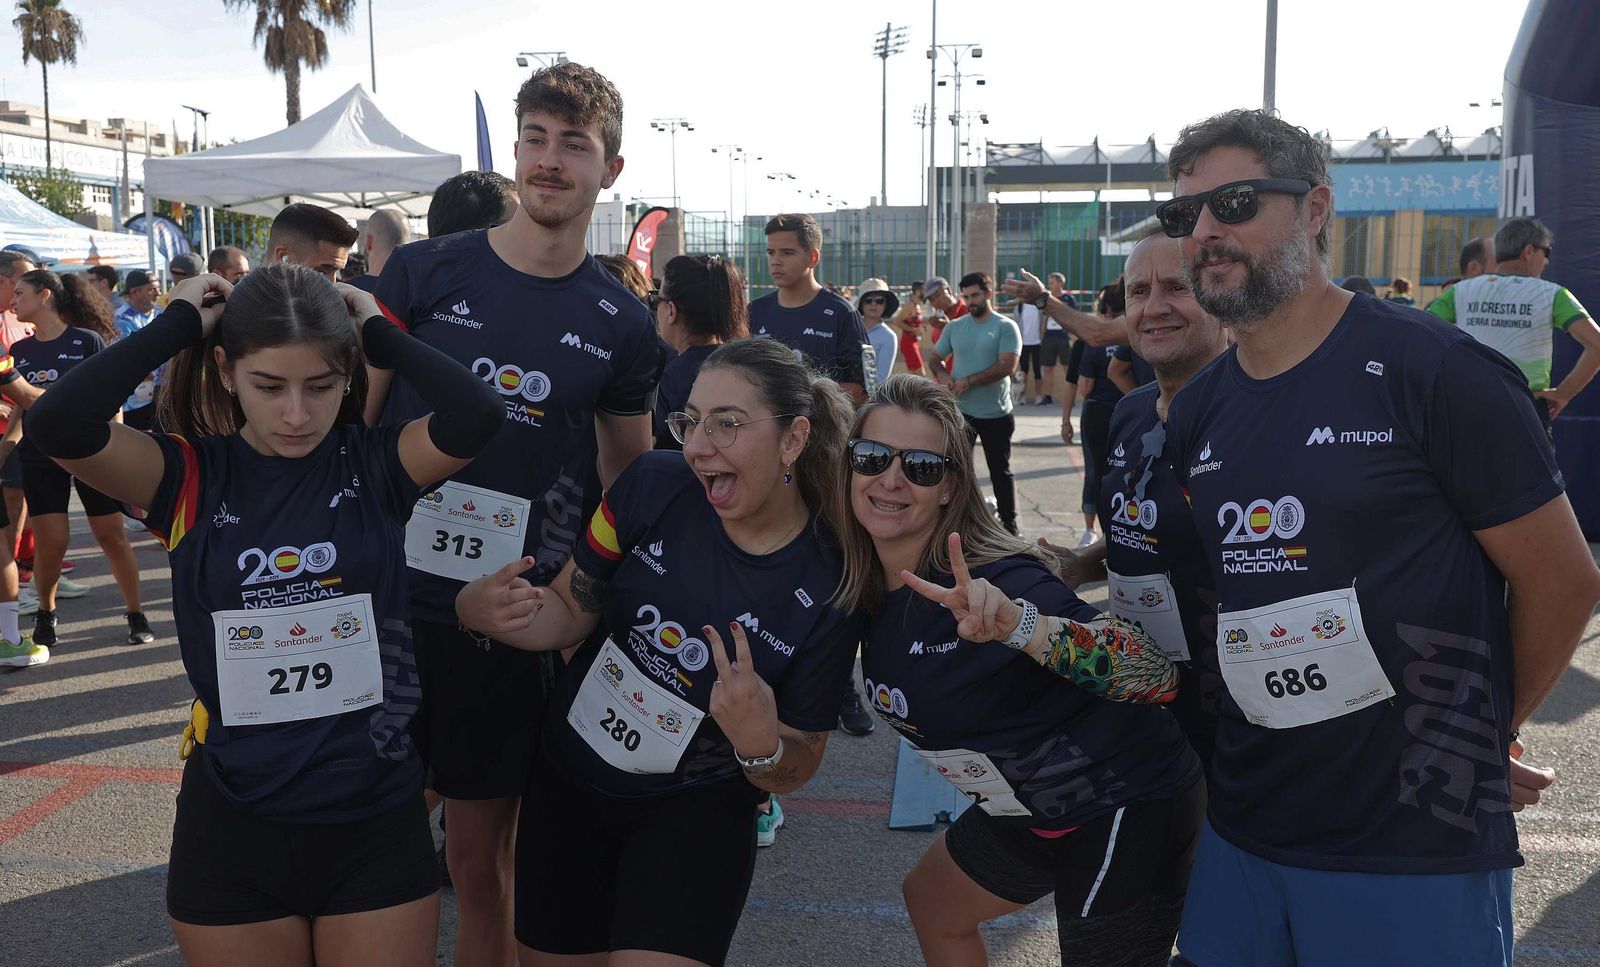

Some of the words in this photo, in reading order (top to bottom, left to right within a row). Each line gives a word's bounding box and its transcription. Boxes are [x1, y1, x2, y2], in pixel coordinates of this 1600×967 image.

[21, 143, 60, 161] LINA
[1468, 302, 1479, 313] XII
[1481, 301, 1516, 315] CRESTA
[1519, 303, 1534, 316] DE
[432, 311, 484, 330] Santander
[584, 343, 613, 361] mupol
[27, 369, 58, 383] 200
[1340, 428, 1393, 446] mupol
[1190, 460, 1222, 478] Santander
[447, 508, 486, 522] Santander
[1111, 491, 1158, 531] 200
[1217, 495, 1305, 544] 200
[432, 529, 484, 560] 313
[1111, 533, 1159, 555] NACIONAL
[237, 542, 337, 586] 200
[1223, 559, 1308, 574] NACIONAL
[244, 588, 343, 610] NACIONAL
[228, 626, 263, 640] 200
[275, 635, 324, 649] Santander
[632, 605, 709, 671] 200
[760, 630, 795, 656] mupol
[1223, 628, 1248, 644] 200
[1260, 635, 1305, 651] Santander
[926, 637, 960, 654] mupol
[604, 657, 624, 681] 200
[628, 637, 687, 697] NACIONAL
[267, 662, 333, 695] 279
[1265, 663, 1328, 699] 686
[622, 691, 651, 718] Santander
[600, 708, 641, 751] 280
